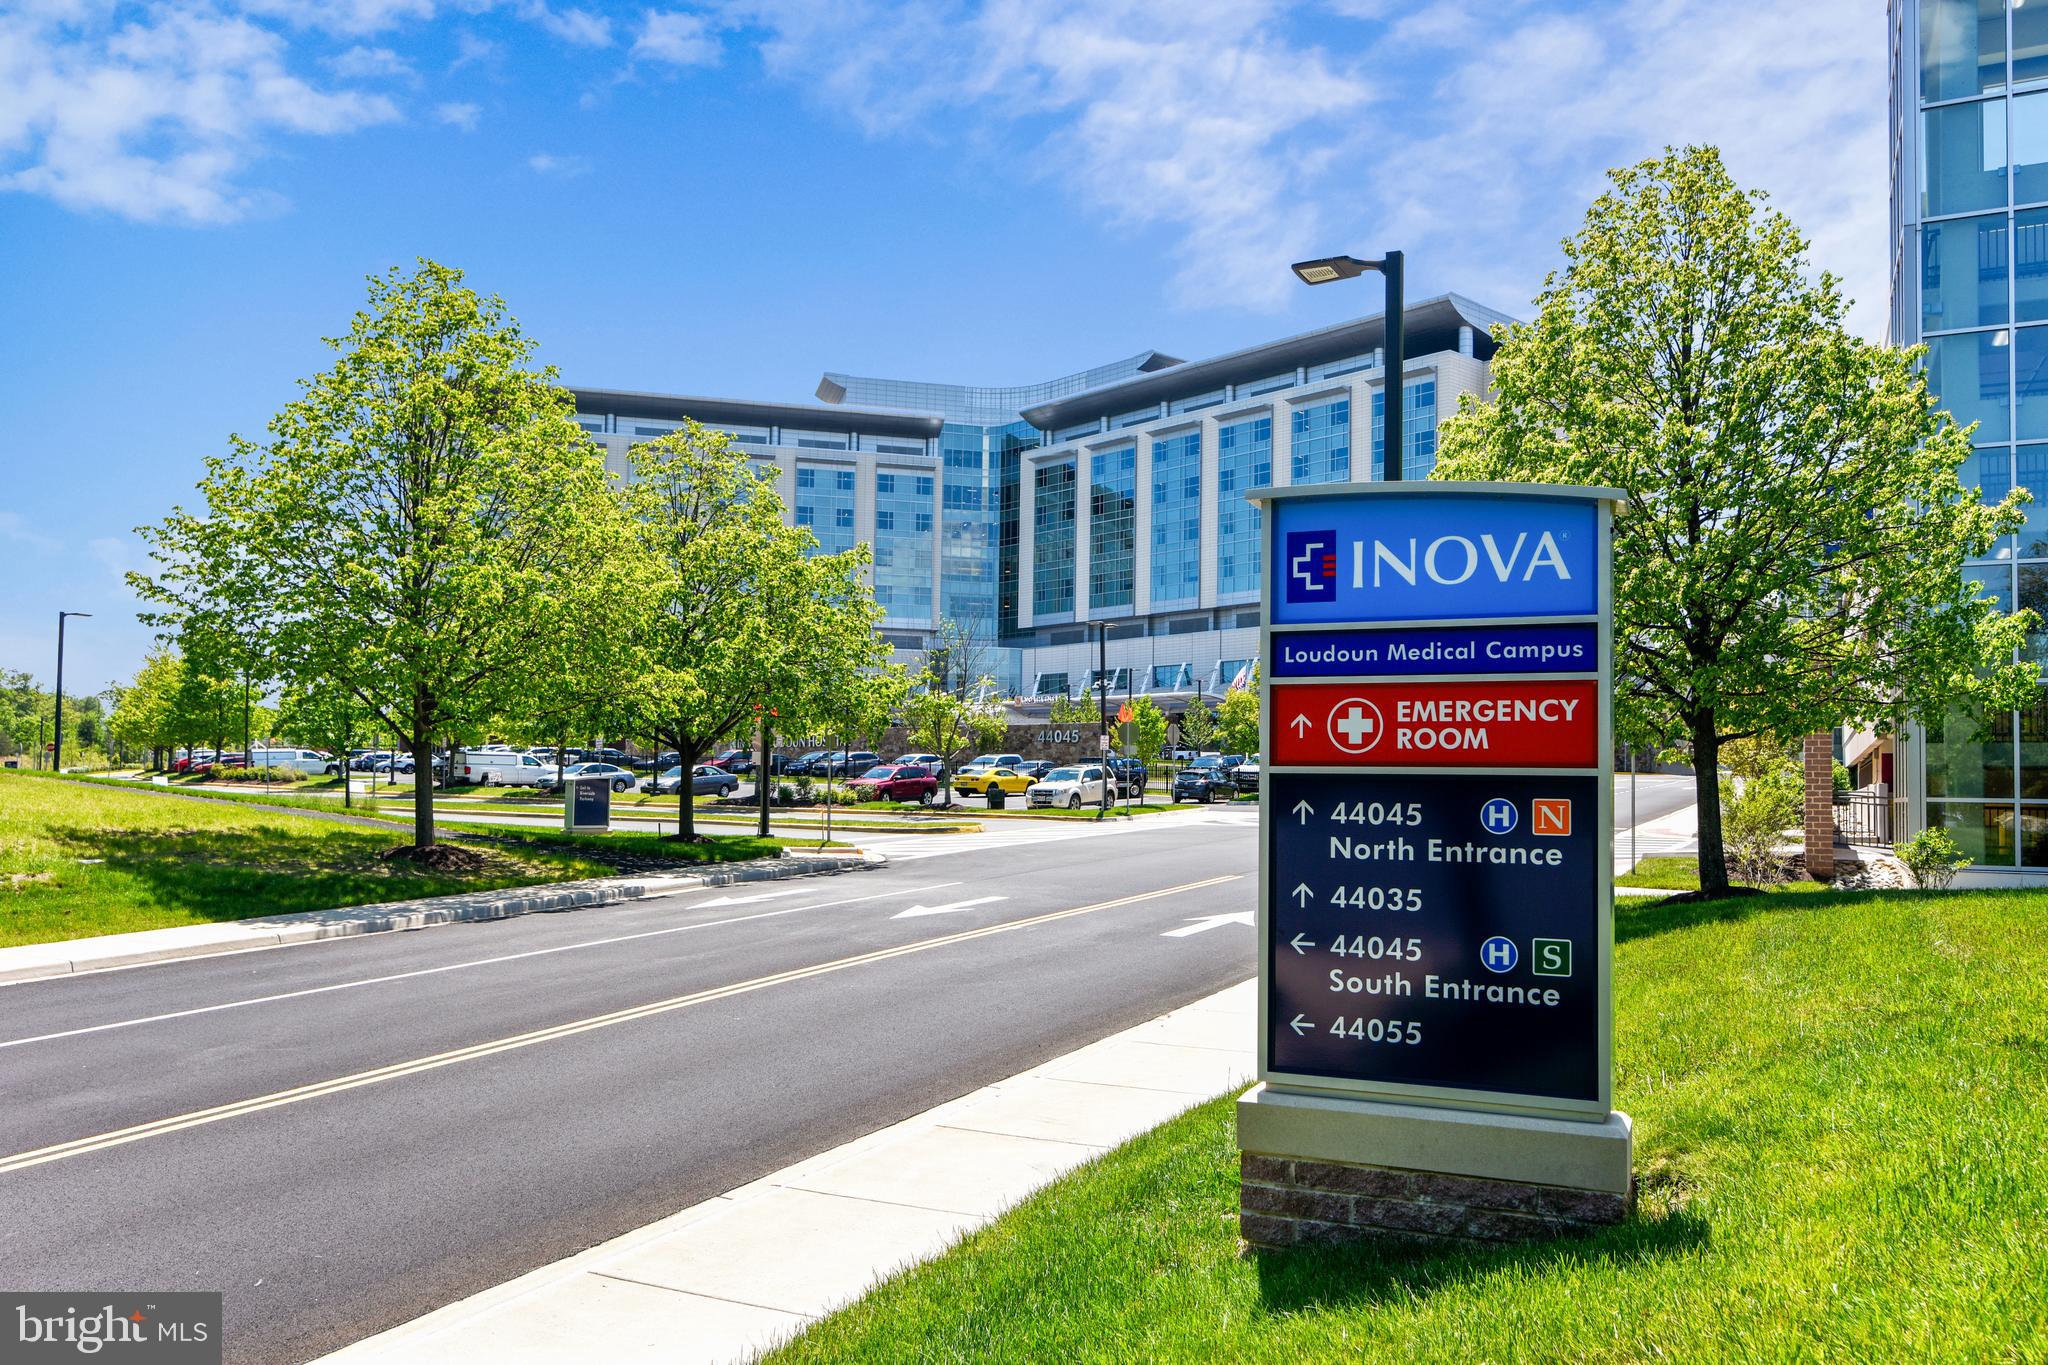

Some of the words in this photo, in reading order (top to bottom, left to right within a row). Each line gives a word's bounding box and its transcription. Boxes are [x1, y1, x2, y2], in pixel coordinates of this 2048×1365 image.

[1352, 531, 1571, 589] INOVA
[1285, 644, 1378, 663] Loudoun
[1387, 640, 1475, 661] Medical
[1485, 641, 1584, 662] Campus
[1397, 699, 1579, 722] EMERGENCY
[1037, 729, 1079, 743] 44045
[1397, 727, 1489, 750] ROOM
[1330, 802, 1422, 826] 44045
[1488, 805, 1510, 828] H
[1538, 805, 1565, 830] N
[1330, 836, 1414, 861] North
[1428, 839, 1563, 866] Entrance
[1330, 886, 1422, 912] 44035
[1330, 935, 1422, 962] 44045
[1488, 942, 1510, 966] H
[1543, 945, 1562, 970] S
[1329, 969, 1411, 996] South
[1425, 975, 1561, 1006] Entrance
[1329, 1016, 1421, 1045] 44055
